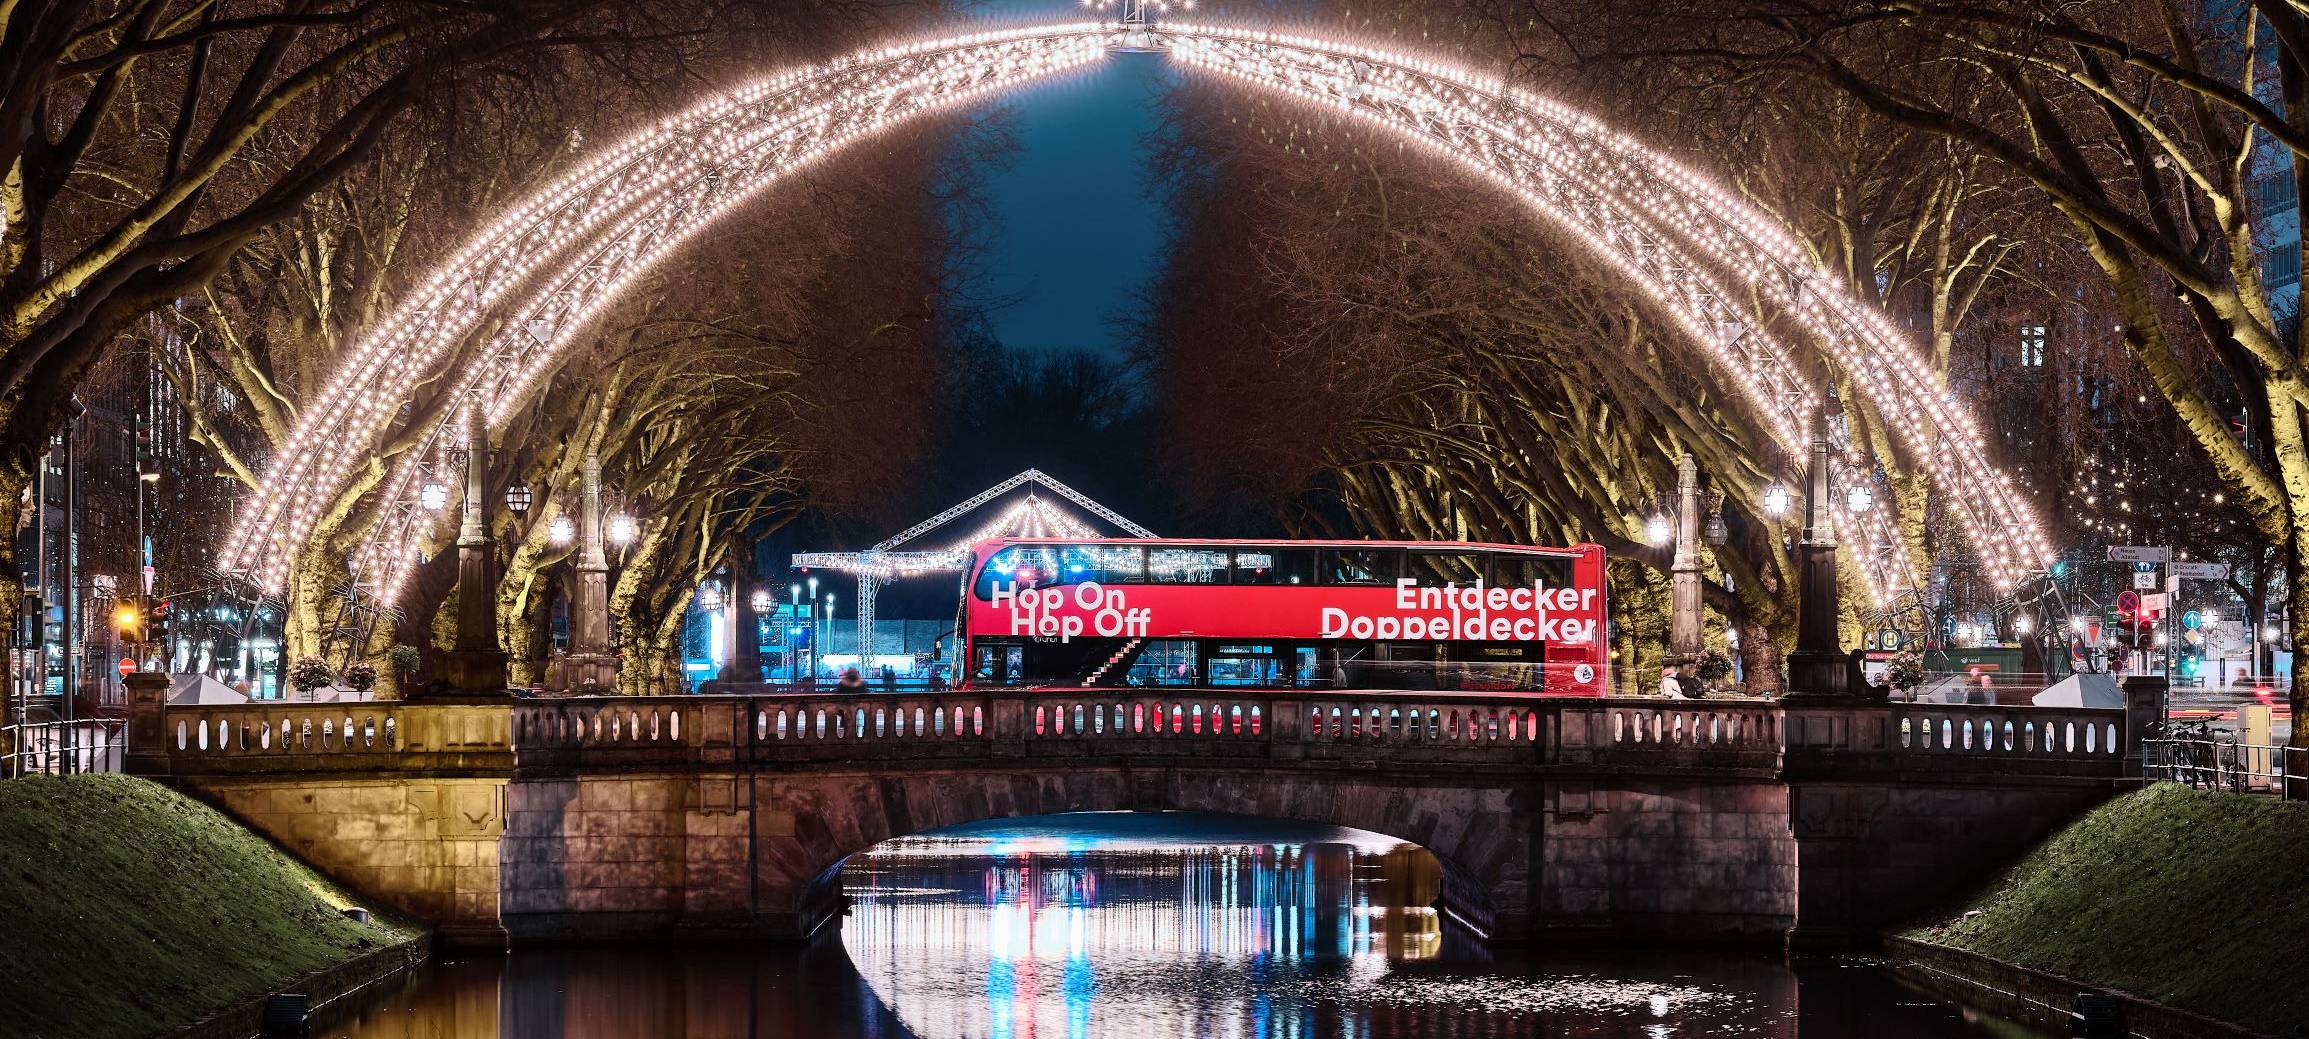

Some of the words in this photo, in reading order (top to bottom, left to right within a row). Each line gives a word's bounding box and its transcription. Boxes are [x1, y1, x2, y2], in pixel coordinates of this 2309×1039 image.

[992, 580, 1063, 617] Hop
[1075, 581, 1125, 609] On
[1396, 578, 1597, 611] Entdecker
[1011, 607, 1083, 643] Hop
[1094, 607, 1151, 637] Off
[1321, 607, 1597, 640] Doppeldecker
